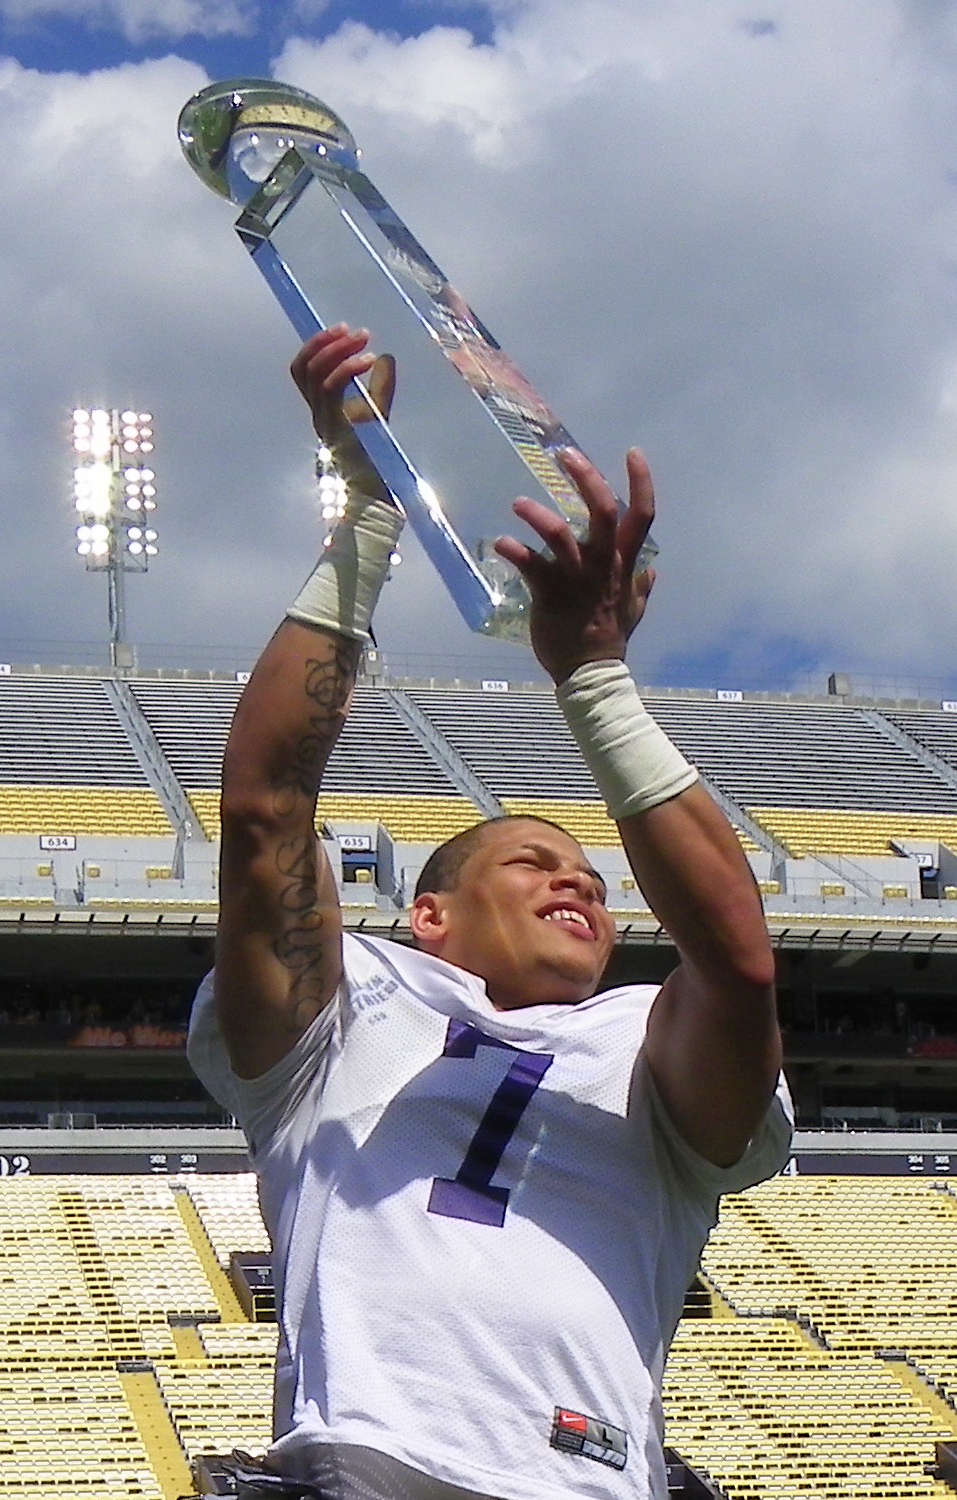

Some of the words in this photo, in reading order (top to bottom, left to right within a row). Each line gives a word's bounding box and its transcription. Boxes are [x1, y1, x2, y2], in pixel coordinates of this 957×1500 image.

[47, 837, 69, 847] 634
[344, 838, 364, 848] 635
[427, 1017, 555, 1228] 7
